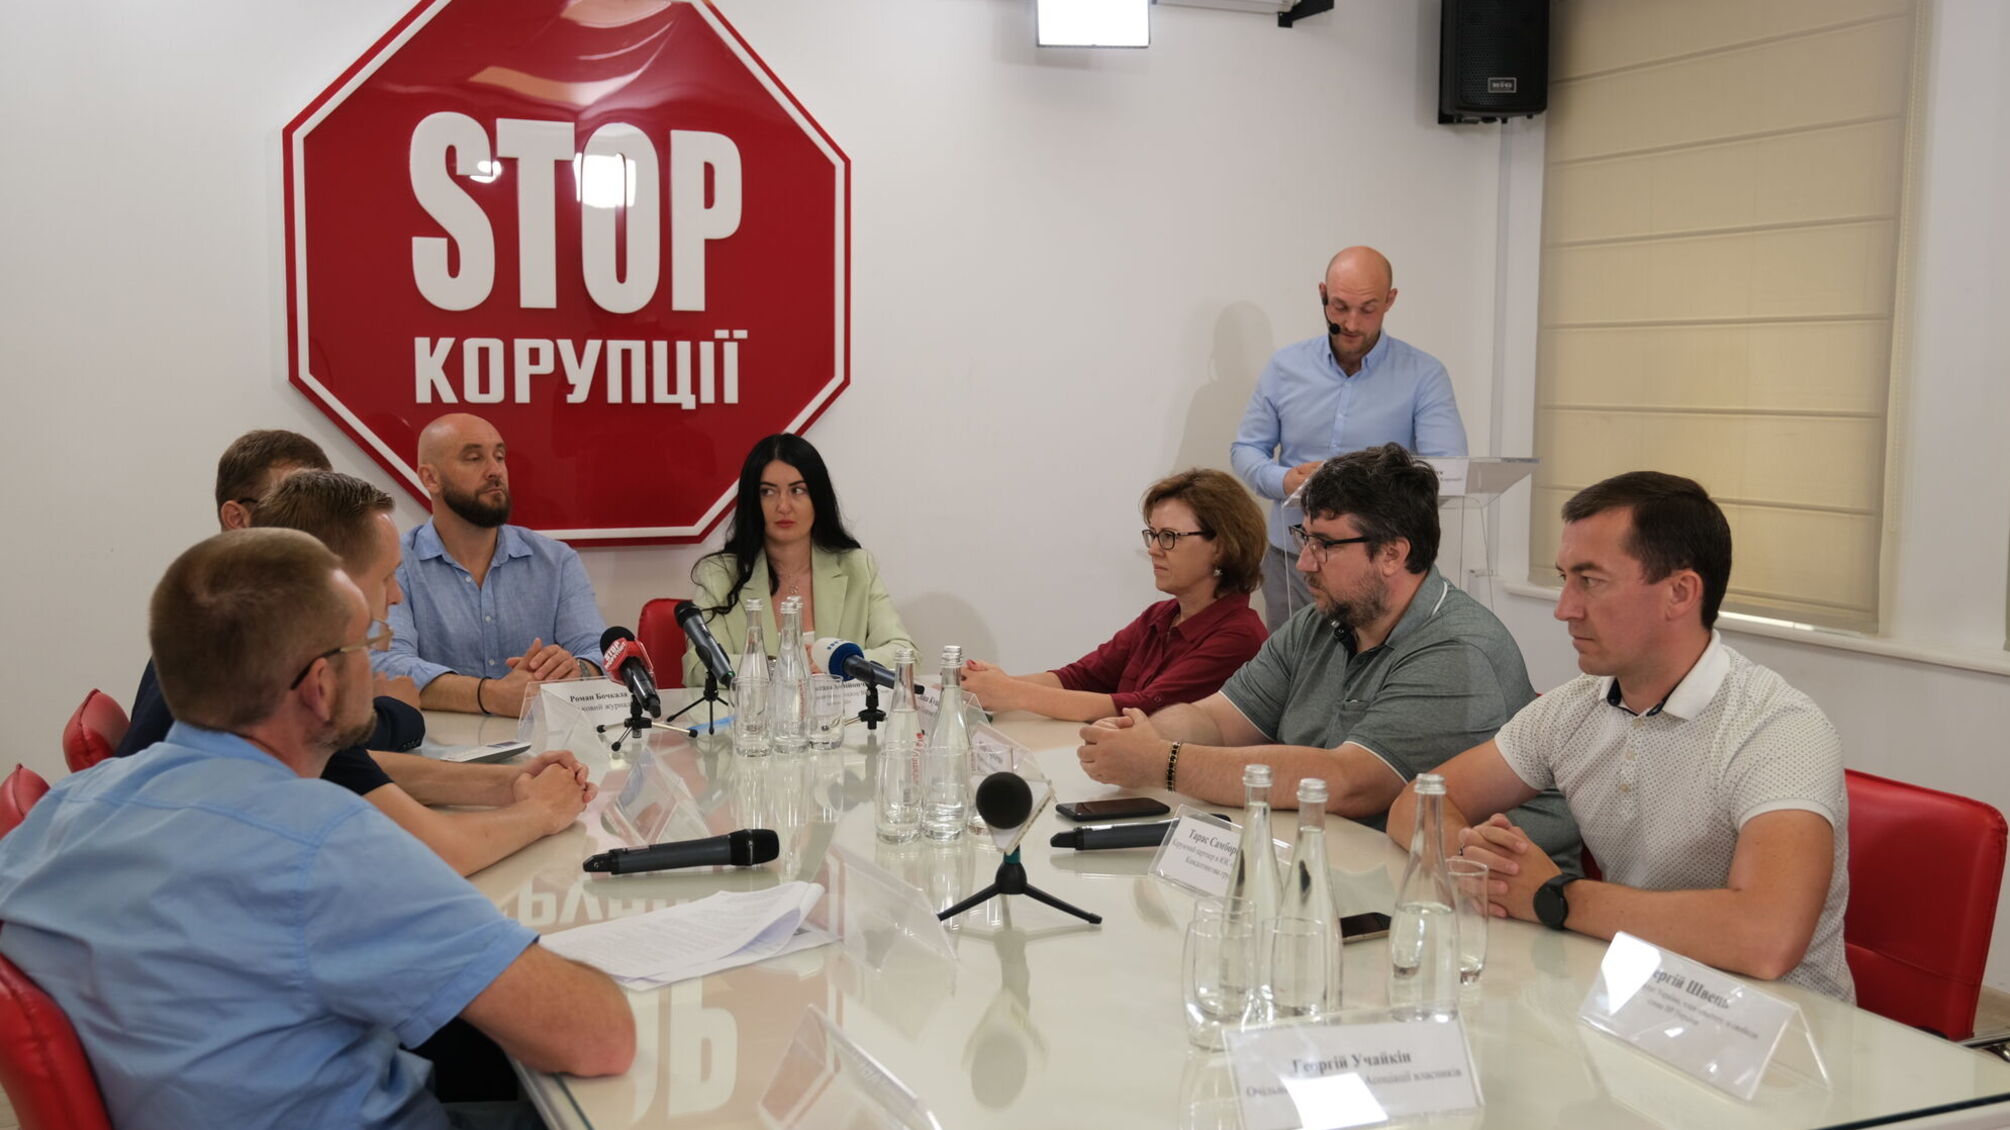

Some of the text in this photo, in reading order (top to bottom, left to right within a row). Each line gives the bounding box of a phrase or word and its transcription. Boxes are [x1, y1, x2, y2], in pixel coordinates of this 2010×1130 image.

[409, 111, 742, 314] STOP
[414, 329, 748, 410] КОРУПЦІЇ
[1189, 829, 1210, 844] Тарас
[1653, 968, 1683, 989] ергій
[1293, 1049, 1411, 1075] Георгій Учайкін
